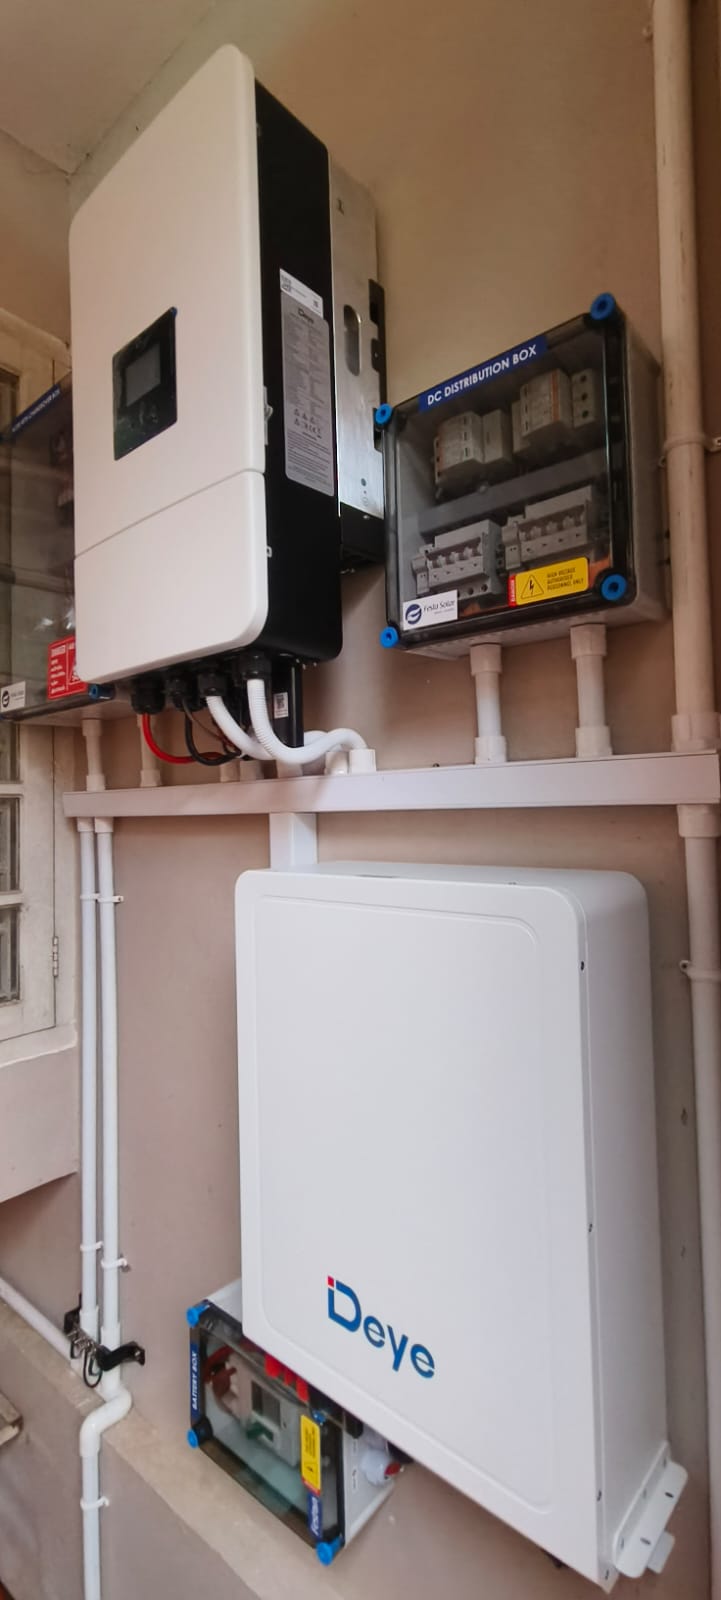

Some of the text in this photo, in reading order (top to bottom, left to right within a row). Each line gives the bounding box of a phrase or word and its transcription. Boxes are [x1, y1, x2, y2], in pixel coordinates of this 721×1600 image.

[427, 344, 537, 406] DC DISTRIBUTION BOX
[327, 1275, 435, 1379] Deye
